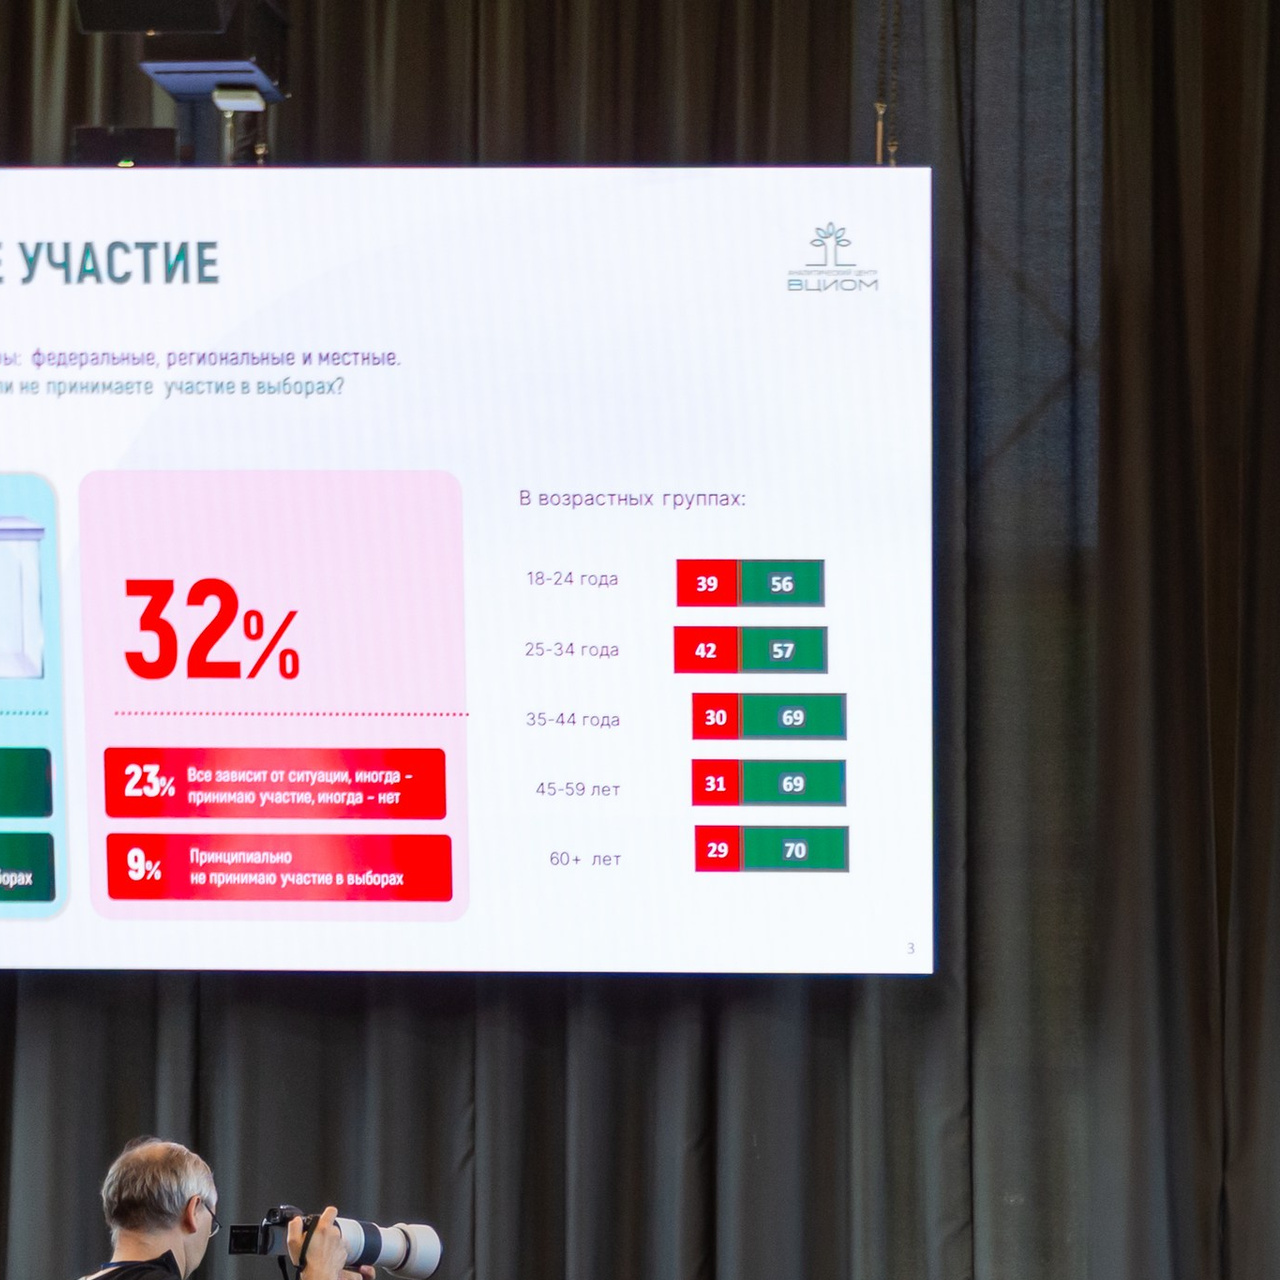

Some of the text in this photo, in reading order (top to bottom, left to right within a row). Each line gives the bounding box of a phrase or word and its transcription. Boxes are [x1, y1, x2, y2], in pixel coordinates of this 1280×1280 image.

[19, 241, 219, 285] УЧАСТИЕ
[787, 278, 878, 292] ВЦИОМ
[0, 348, 401, 370] ы: федеральные, региональные и местные.
[20, 381, 40, 395] не
[47, 381, 154, 399] принимаете
[165, 381, 236, 399] участие
[241, 381, 251, 395] в
[257, 376, 345, 399] выборах?
[520, 490, 746, 510] В возрастных группах:
[527, 571, 619, 588] 18-24 года
[697, 576, 719, 592] 39
[771, 576, 794, 592] 56
[125, 578, 300, 680] 32%
[525, 642, 620, 659] 25-34 года
[695, 643, 717, 658] 42
[772, 643, 795, 658] 57
[526, 712, 621, 729] 35-44 года
[705, 710, 728, 725] 30
[782, 710, 804, 726] 69
[125, 764, 175, 798] 23%
[188, 767, 213, 783] Все
[215, 768, 269, 783] зависит
[271, 770, 285, 783] от
[288, 770, 353, 786] ситуации,
[355, 771, 401, 785] иногда
[705, 776, 727, 792] 31
[782, 776, 804, 792] 69
[535, 782, 621, 797] 45-59 лет
[188, 790, 257, 807] принимаю
[260, 791, 315, 807] участие,
[318, 792, 364, 807] иногда
[378, 791, 401, 804] нет
[189, 847, 293, 866] Принципиально
[707, 842, 729, 858] 29
[784, 842, 807, 858] 70
[127, 848, 161, 880] 9%
[549, 852, 622, 867] 60+ лет
[0, 869, 33, 888] орах
[190, 870, 404, 888] не принимаю участие в выборах
[907, 942, 916, 954] 3
